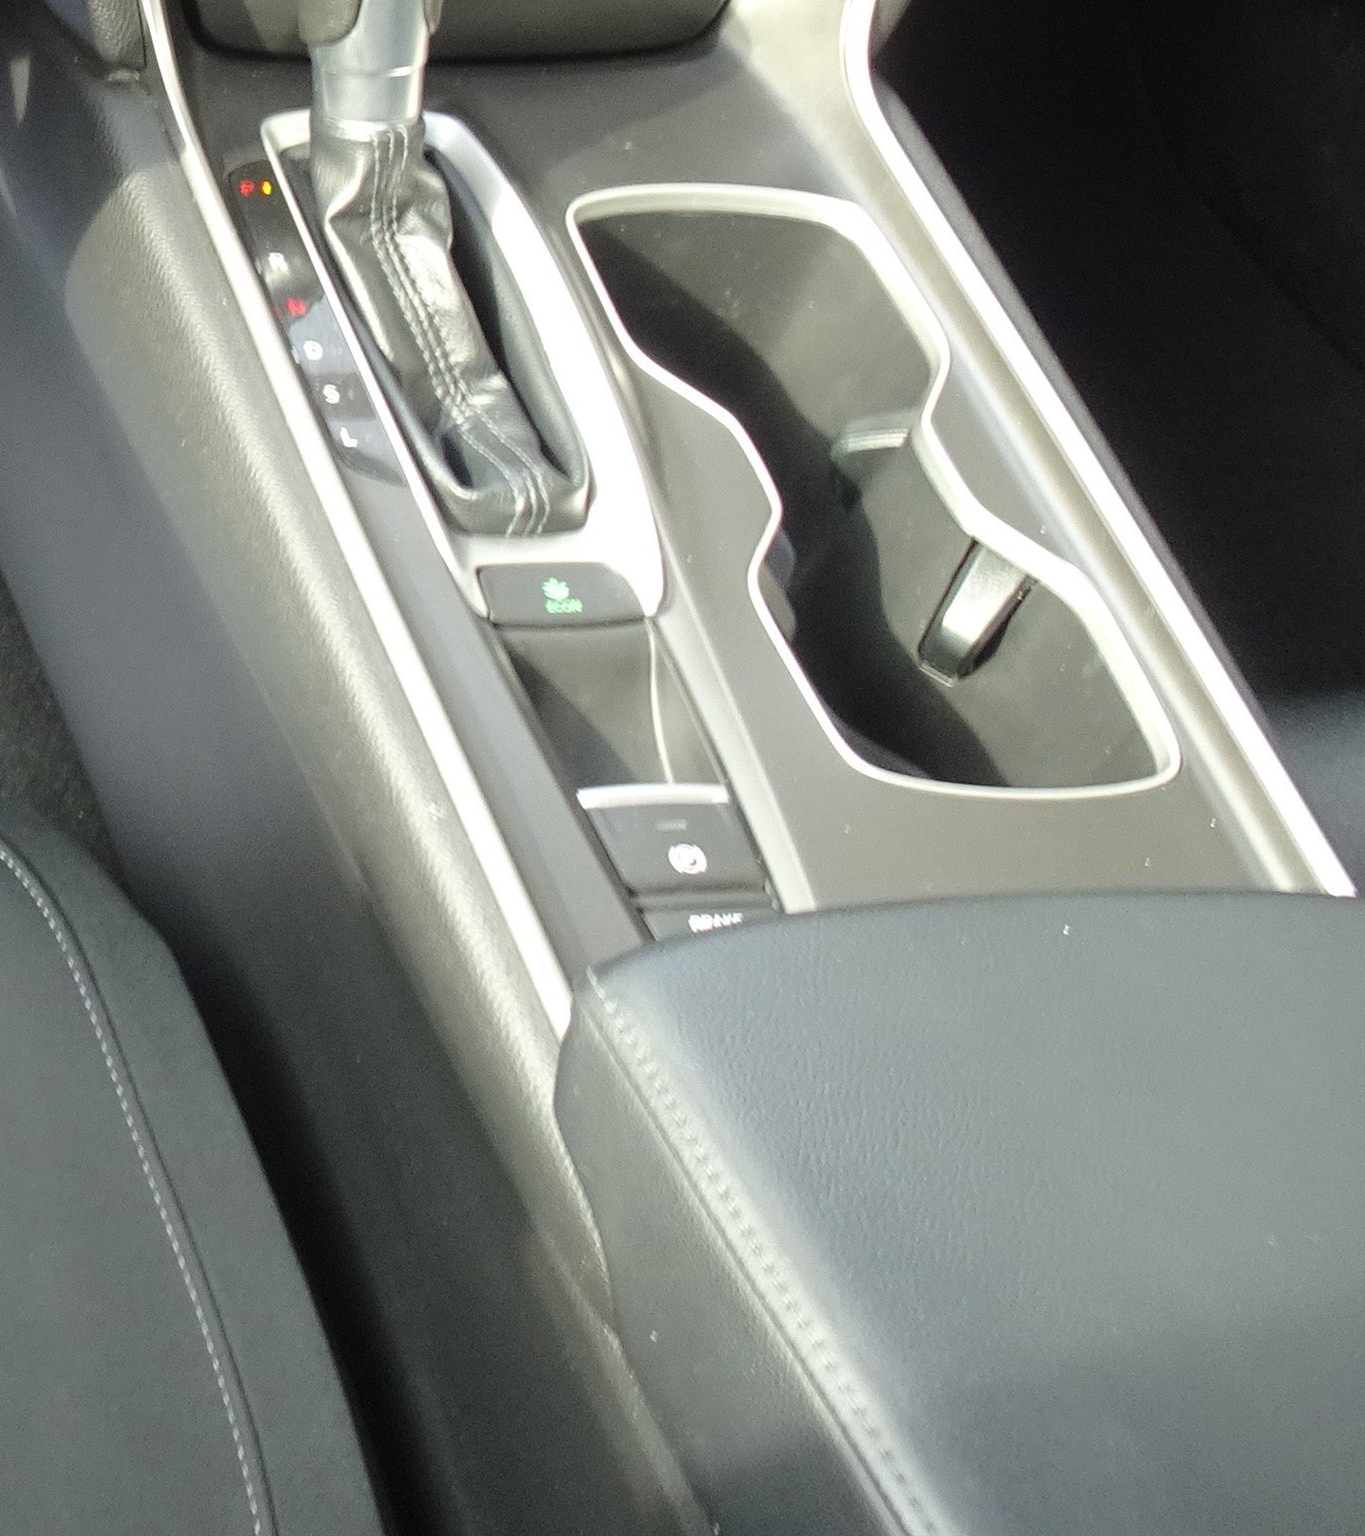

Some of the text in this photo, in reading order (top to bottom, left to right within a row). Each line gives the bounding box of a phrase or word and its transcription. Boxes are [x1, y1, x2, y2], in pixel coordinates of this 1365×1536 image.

[303, 340, 323, 361] D
[323, 383, 340, 405] S
[339, 426, 358, 448] L
